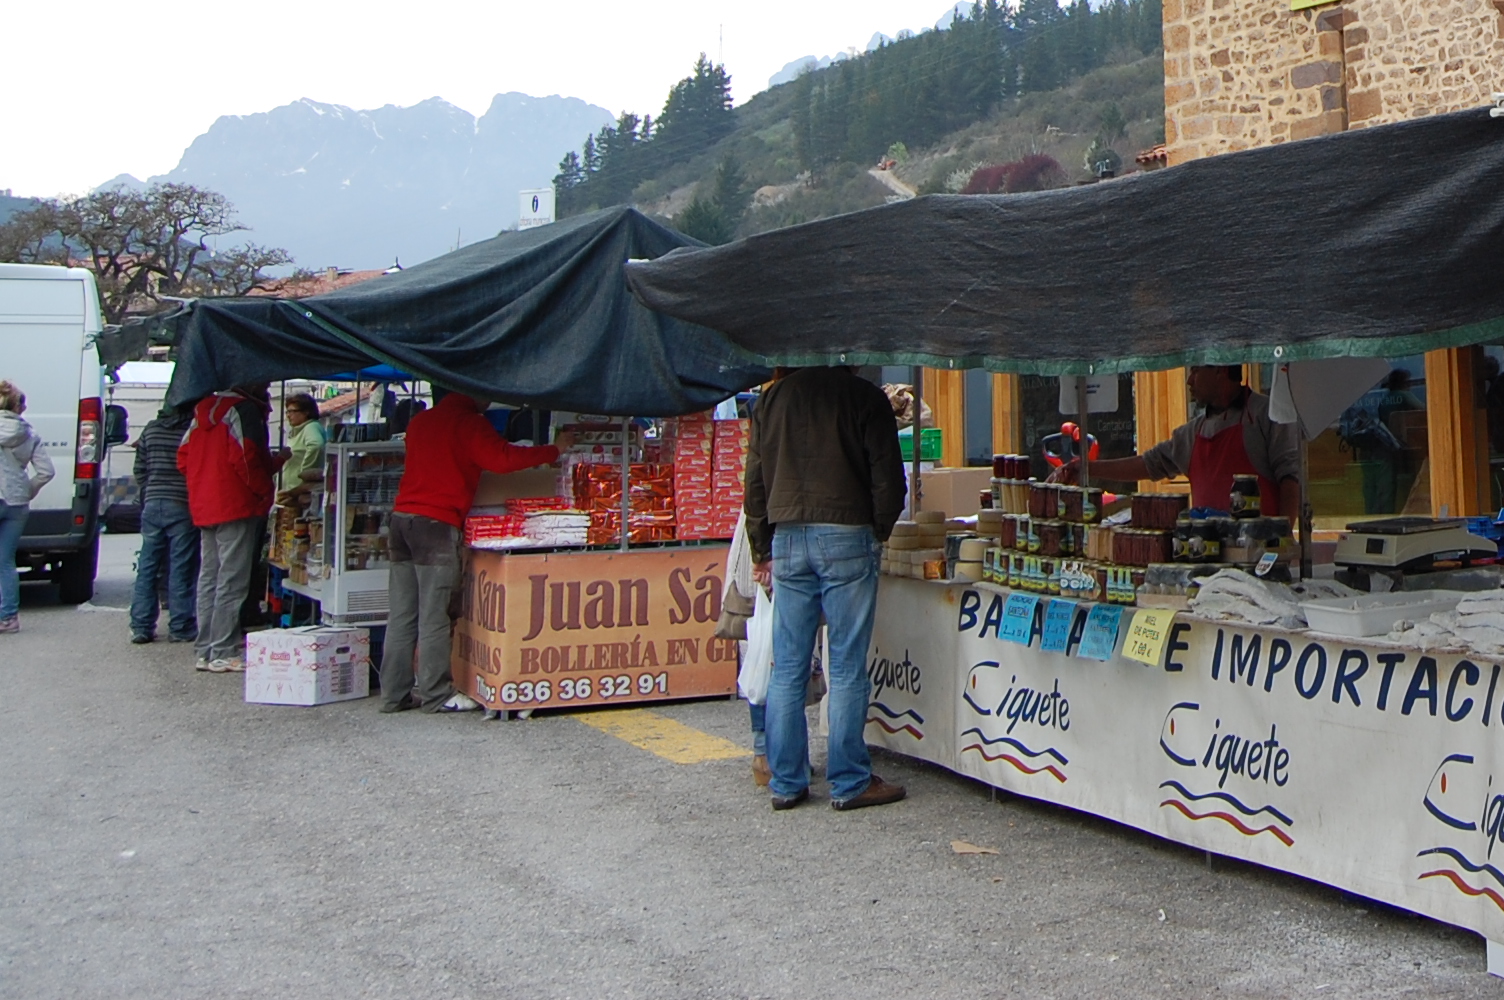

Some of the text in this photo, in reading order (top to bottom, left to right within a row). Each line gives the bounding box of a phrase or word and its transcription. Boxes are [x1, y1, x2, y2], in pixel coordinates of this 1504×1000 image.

[477, 569, 507, 633] San
[521, 573, 649, 642] Juan
[668, 563, 723, 626] Sá
[518, 633, 660, 675] BOLLERÍA
[665, 637, 701, 666] EN
[705, 636, 738, 664] GE
[867, 646, 922, 700] iquete
[500, 680, 552, 704] 636
[558, 677, 593, 701] 36
[598, 675, 632, 699] 32
[637, 672, 670, 695] 91
[1160, 702, 1290, 789] Ciquete
